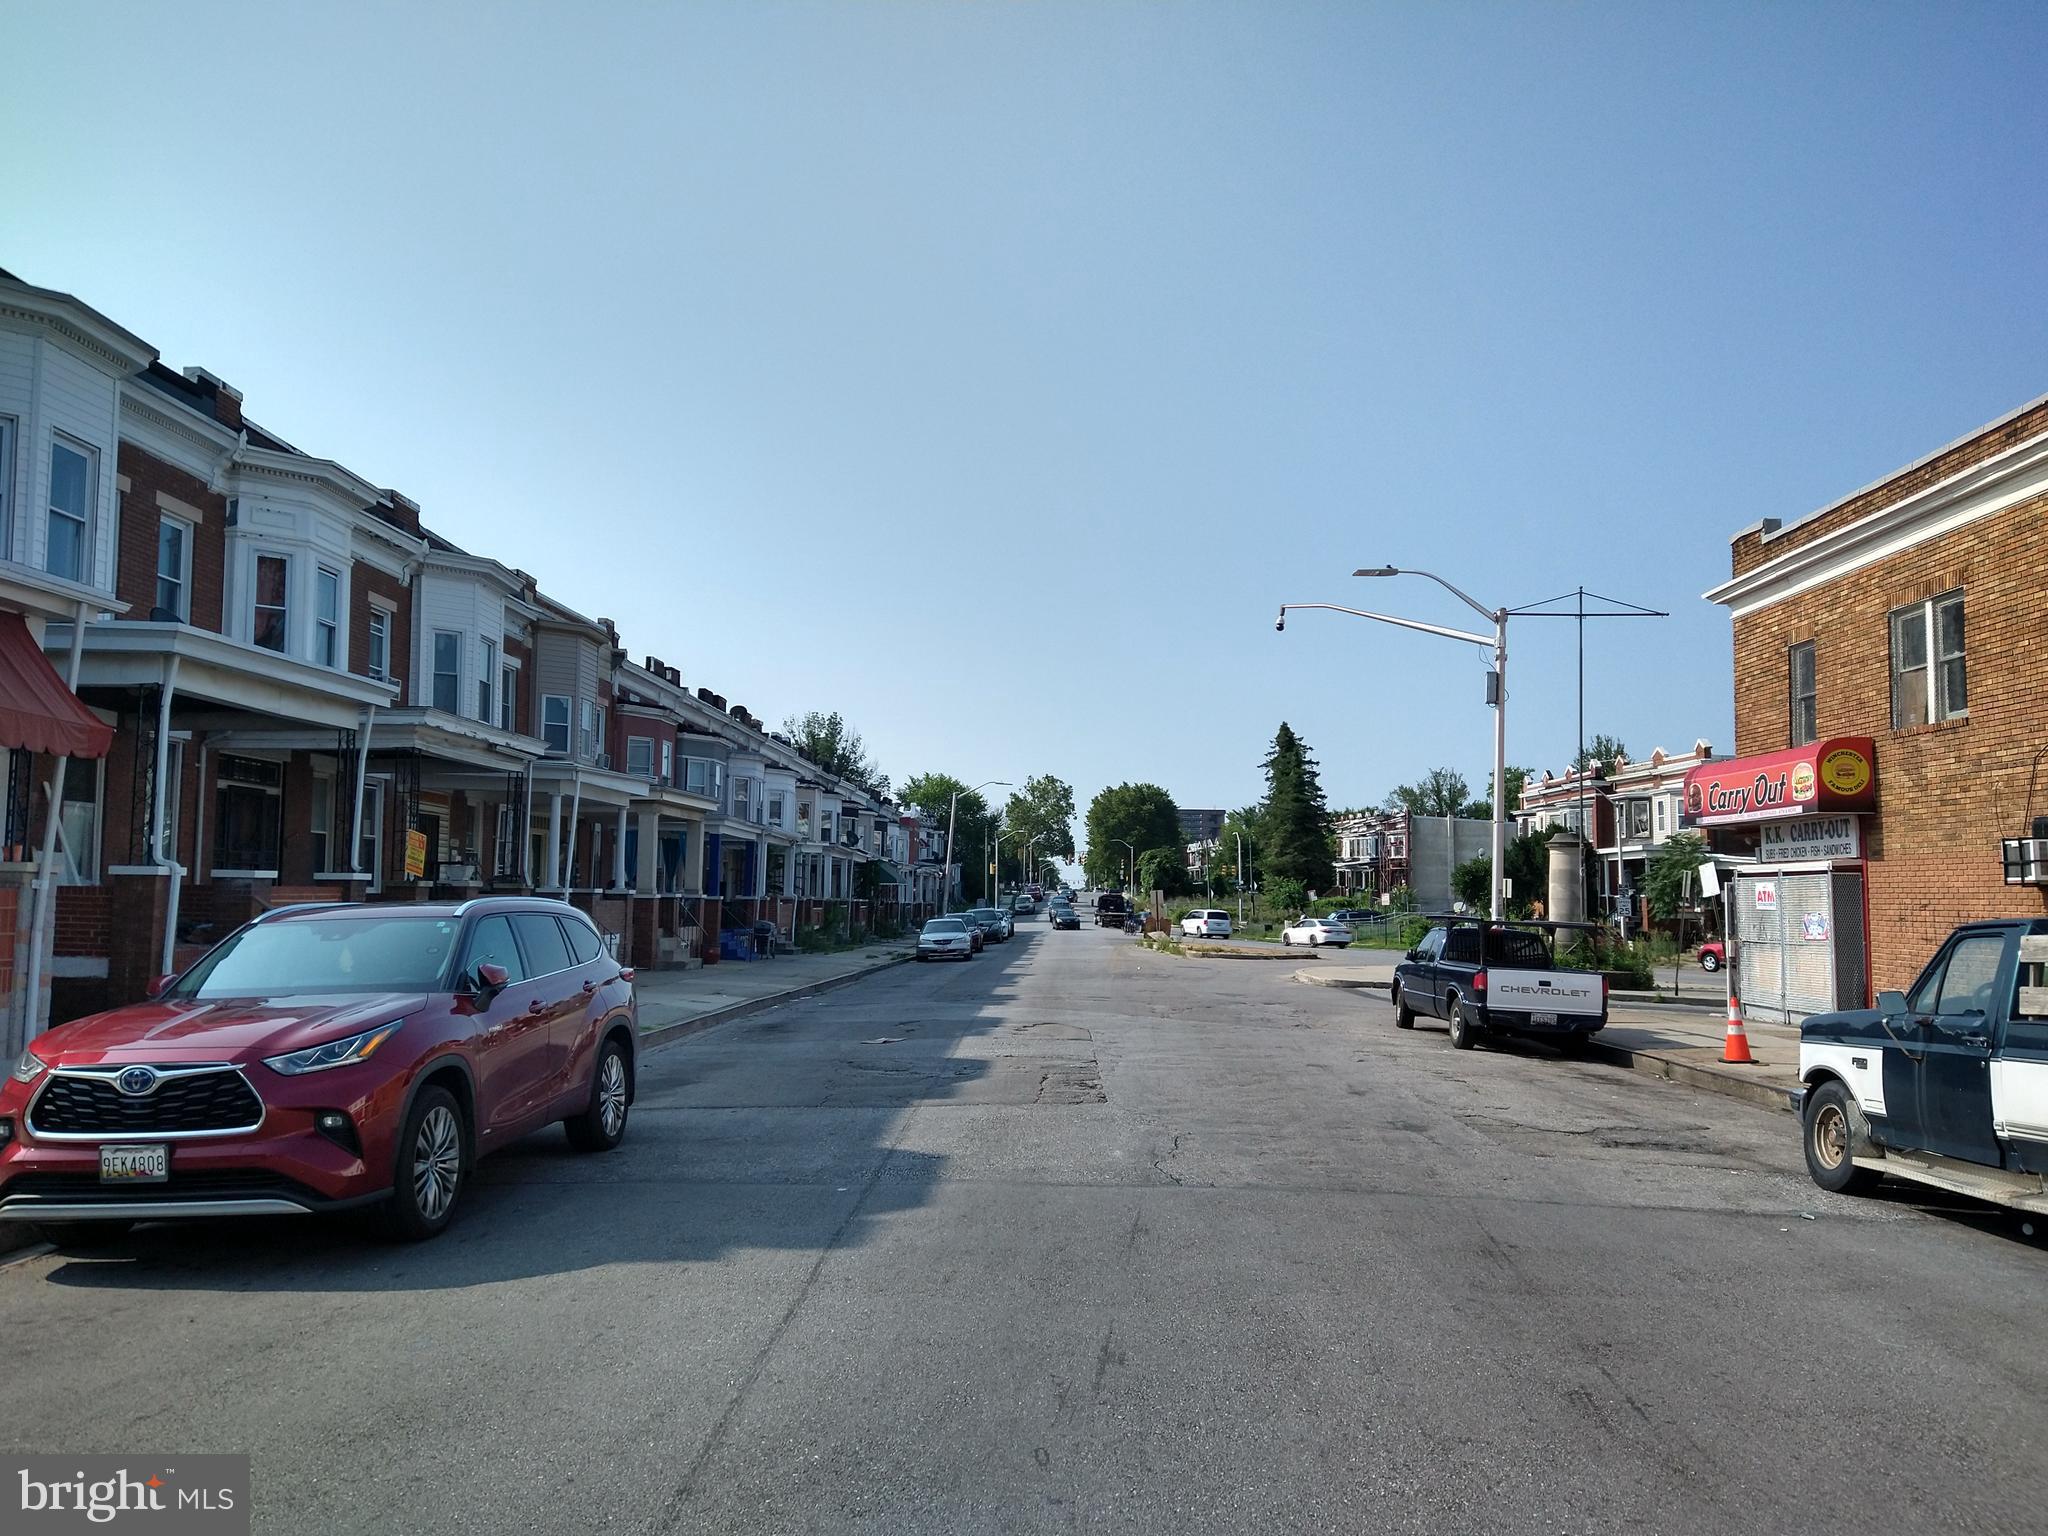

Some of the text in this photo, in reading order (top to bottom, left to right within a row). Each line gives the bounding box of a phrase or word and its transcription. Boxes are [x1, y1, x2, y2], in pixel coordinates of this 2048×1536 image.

[1826, 751, 1864, 763] WINCHESTER
[1828, 780, 1854, 792] FAMOUS
[1709, 772, 1787, 814] Carry Out
[1765, 818, 1850, 844] K.K. CARRY-OUT
[1766, 842, 1851, 859] SUBS FRIED CHICKEN FISH SANDWICHES
[1757, 890, 1775, 902] ATM
[1619, 907, 1631, 915] 25
[1500, 985, 1591, 997] CHEVROLET
[103, 1155, 164, 1176] 9EK4808
